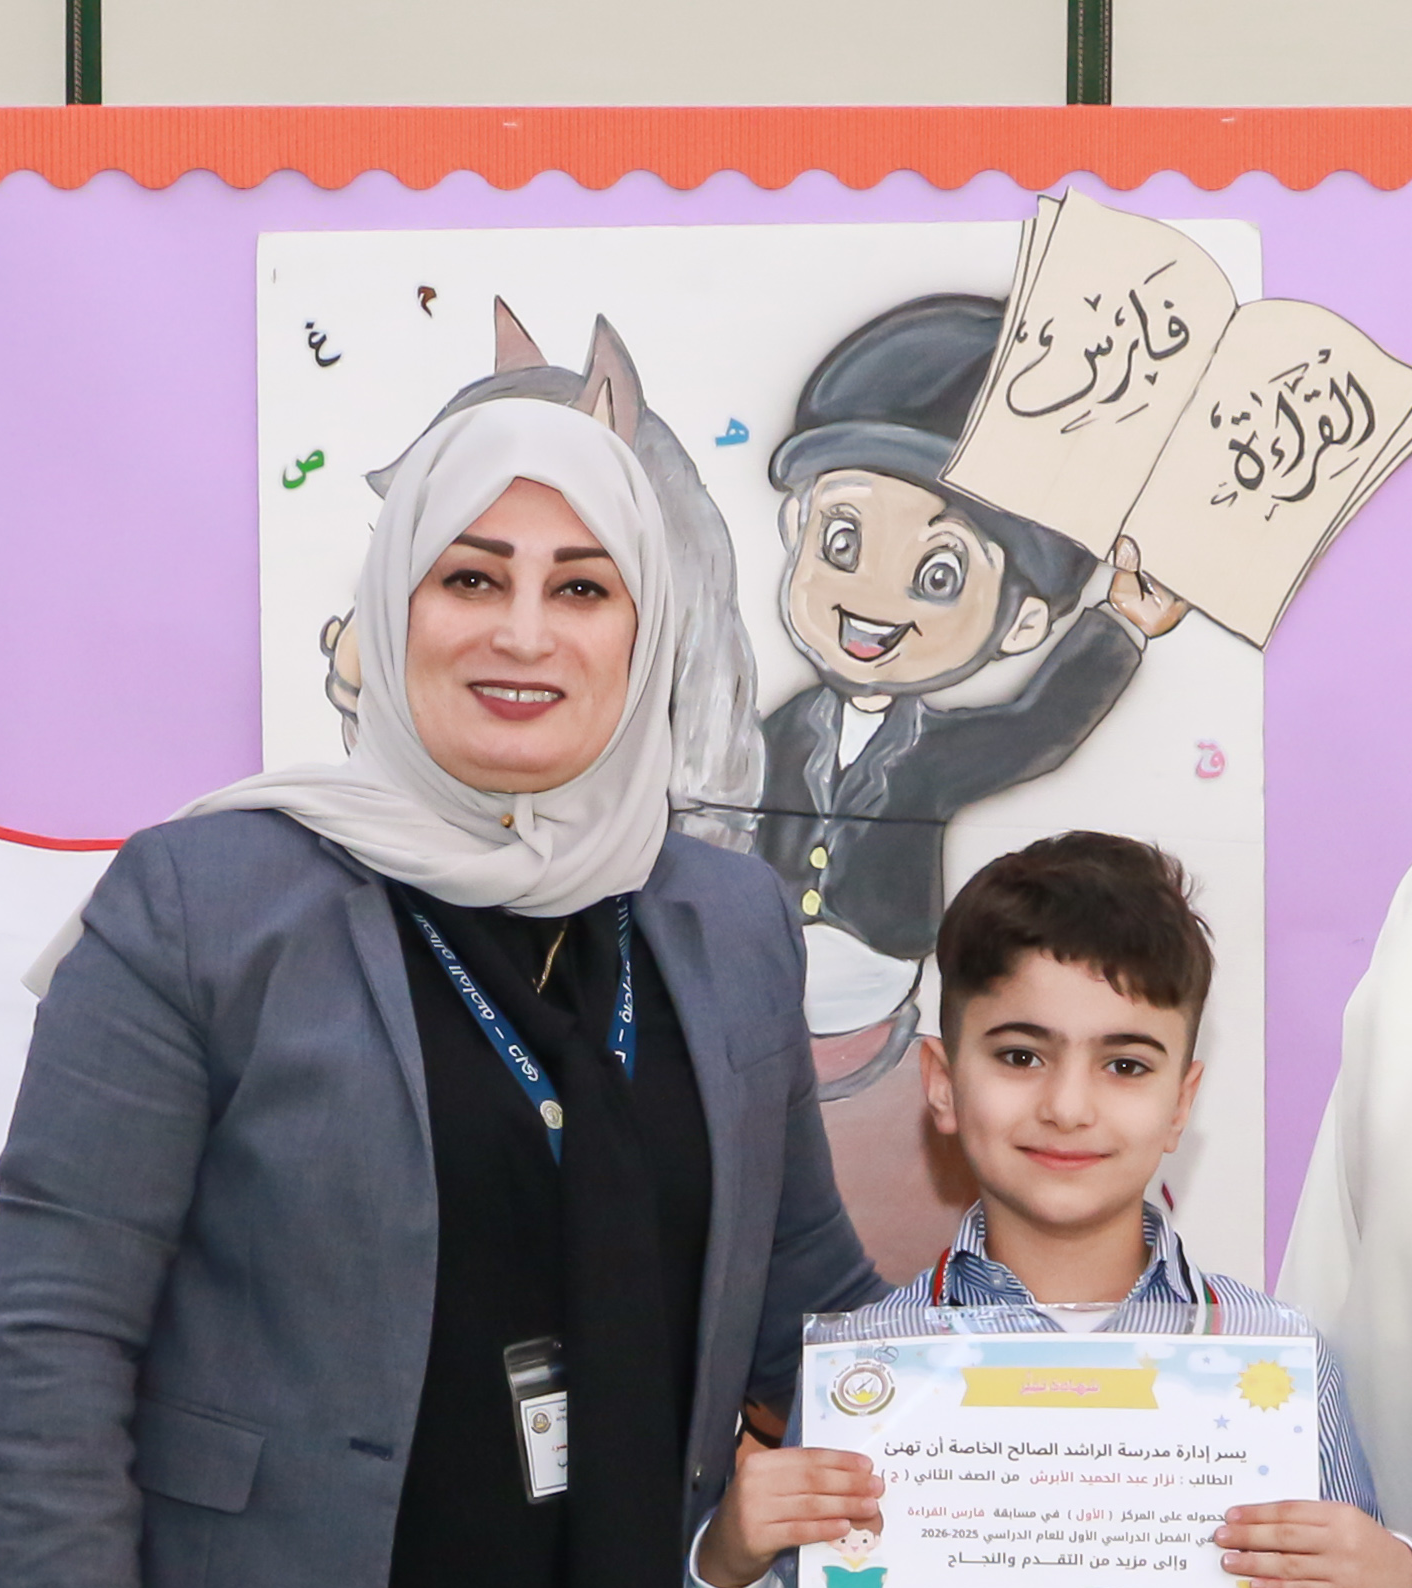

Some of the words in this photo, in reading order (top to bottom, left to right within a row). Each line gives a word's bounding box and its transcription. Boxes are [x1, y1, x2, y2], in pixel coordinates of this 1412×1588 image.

[304, 321, 343, 367] غ
[282, 448, 325, 489] ص
[1194, 741, 1226, 779] ق
[449, 965, 496, 1021] الخاصة
[508, 1044, 539, 1082] دبي
[926, 1435, 944, 1458] أن
[948, 1439, 1003, 1456] الخاصة
[1007, 1441, 1059, 1462] الصالح
[1063, 1442, 1112, 1461] الراشد
[1117, 1442, 1171, 1461] مدرسة
[1176, 1444, 1210, 1464] إدارة
[1214, 1449, 1248, 1464] يسر
[913, 1468, 953, 1486] الثاني
[958, 1469, 996, 1482] الصف
[1001, 1472, 1020, 1485] من
[1029, 1470, 1074, 1485] الأبرش
[1079, 1472, 1121, 1486] الحميد
[1126, 1474, 1148, 1487] عبد
[1152, 1473, 1175, 1487] نزار
[1188, 1474, 1233, 1488] الطالب
[907, 1506, 947, 1519] القراءة
[951, 1506, 985, 1519] فارس
[993, 1508, 1037, 1520] مسابقة
[1040, 1509, 1060, 1523] في
[1076, 1509, 1104, 1522] الأول
[1120, 1510, 1155, 1523] المركز
[1159, 1510, 1182, 1524] على
[1186, 1511, 1226, 1523] حصوله
[982, 1529, 1032, 1544] الدراسي
[1035, 1530, 1064, 1543] للعام
[1068, 1530, 1097, 1544] الأول
[1101, 1531, 1150, 1547] الدراسي
[1154, 1532, 1191, 1545] الفصل
[1089, 1556, 1110, 1570] من
[1115, 1557, 1148, 1570] مزيد
[1153, 1555, 1188, 1571] وإلى
